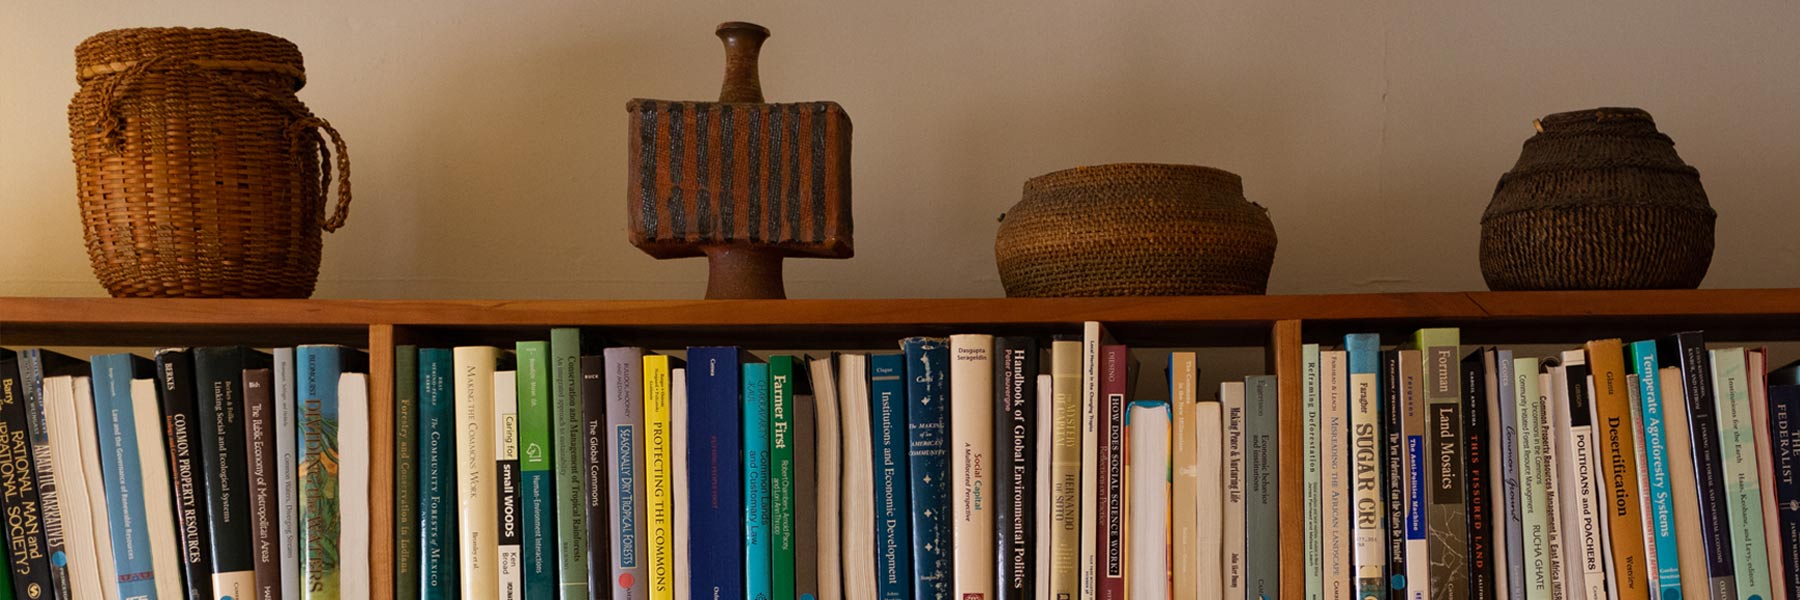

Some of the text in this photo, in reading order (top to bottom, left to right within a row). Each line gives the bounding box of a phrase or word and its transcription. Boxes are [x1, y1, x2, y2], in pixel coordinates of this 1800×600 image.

[2, 378, 14, 404] Barry
[164, 363, 175, 390] BERKES
[1004, 371, 1012, 412] Dauvergne
[1307, 362, 1316, 408] Reframing
[1438, 350, 1450, 392] Forman
[112, 409, 120, 422] Law
[251, 403, 262, 418] The
[774, 375, 787, 448] Farmer First
[1110, 398, 1120, 423] HOW
[1228, 408, 1241, 430] Making
[1359, 383, 1368, 413] Faragher
[1531, 402, 1540, 436] Uncommons
[1728, 378, 1737, 418] Institutions
[1735, 444, 1743, 463] Earth
[114, 424, 122, 435] and
[116, 436, 124, 447] the
[173, 414, 186, 456] COMMON
[214, 382, 231, 522] Linking Social and Ecological Systems
[252, 420, 264, 440] Public
[305, 399, 321, 483] DIVIDING
[505, 416, 515, 457] Caring for
[1111, 425, 1120, 452] DOES
[1230, 432, 1241, 449] Peace
[1308, 412, 1316, 472] Deforestation
[1330, 416, 1339, 469] MISREADING
[1439, 408, 1456, 489] Land Mosaics
[1518, 375, 1534, 513] Community Initiated Forest Resource Management
[1643, 354, 1670, 537] Temperate Agroforestry Systems
[1777, 404, 1792, 484] FEDERALIST
[34, 444, 54, 489] ANALYTIC
[117, 448, 128, 483] Governance
[253, 442, 266, 477] Economy
[431, 431, 440, 491] COMMUNITY
[567, 356, 582, 562] Conservation and Management of Tropical Rainforests
[589, 420, 600, 506] The Global Commons
[654, 422, 664, 496] PROTECTING
[1014, 350, 1026, 588] Handbook of Global Environmental Politics
[1111, 454, 1120, 490] SOCIAL
[1228, 458, 1241, 489] Nurturing
[1260, 435, 1270, 504] Economic behavior
[1356, 424, 1376, 490] SUGAR
[1505, 426, 1520, 522] Common Ground
[1535, 457, 1543, 484] Commons
[1608, 417, 1629, 516] Desertification
[11, 430, 42, 558] RATIONAL MAN and
[179, 458, 195, 506] PROPERTY
[398, 400, 410, 573] Forestry and Conservation in Indiana
[503, 464, 514, 537] small WOODS
[620, 429, 634, 564] SEASONALLY DRY TROPICAL FORESTS
[748, 450, 758, 544] and Customary Law
[760, 450, 770, 525] Common Lands
[882, 391, 897, 584] Institutions and Economic Development
[973, 453, 983, 510] Social Capital
[1065, 474, 1074, 530] HERNANDO
[1230, 491, 1241, 502] Life
[1470, 434, 1484, 568] THIS FISSURED LAND
[1577, 434, 1596, 570] POLITICIANS and POACHERS
[1738, 473, 1746, 492] Haas,
[41, 492, 63, 547] NARRATIVES
[122, 494, 132, 528] Renewable
[256, 487, 269, 538] Metropolitan
[431, 496, 440, 536] FORESTS
[532, 475, 544, 573] Human-Environment Interactions
[655, 501, 664, 524] THE
[1110, 493, 1120, 540] SCIENCE
[1739, 494, 1749, 527] Keohane,
[8, 505, 30, 574] SOCIETY?
[124, 530, 135, 560] Resources
[184, 509, 201, 563] RESOURCES
[260, 540, 270, 563] Areas
[306, 515, 323, 592] WATERS
[656, 528, 665, 592] COMMONS
[1532, 525, 1544, 590] RUCHA GHATE
[1744, 543, 1754, 561] Levy,
[431, 548, 440, 586] MEXICO
[501, 553, 510, 574] Broad
[1625, 556, 1635, 589] Westview
[1746, 563, 1756, 587] editors
